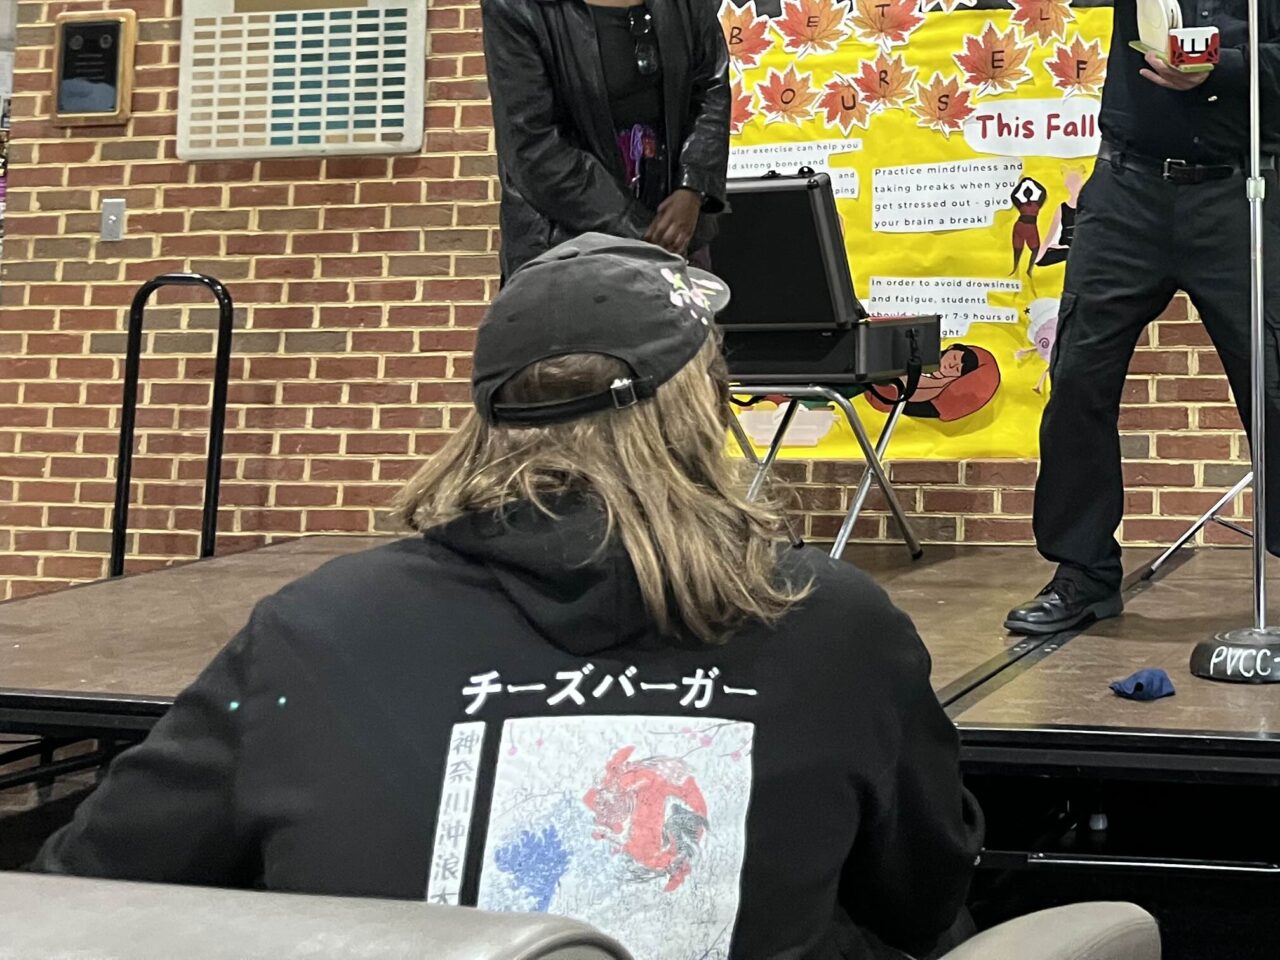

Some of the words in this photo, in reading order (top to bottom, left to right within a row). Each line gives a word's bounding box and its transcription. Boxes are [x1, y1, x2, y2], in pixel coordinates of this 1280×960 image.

[976, 114, 1034, 139] This
[1046, 113, 1094, 139] Fall
[754, 146, 792, 154] exercise
[817, 143, 837, 151] help
[776, 160, 803, 168] bones
[875, 168, 922, 176] Practice
[928, 164, 998, 174] mindfulness
[1003, 162, 1023, 170] and
[875, 185, 910, 193] taking
[917, 183, 955, 191] breaks
[961, 182, 990, 190] when
[996, 182, 1015, 190] you
[875, 203, 893, 211] get
[898, 201, 946, 209] stressed
[985, 198, 1008, 207] give
[875, 220, 899, 228] your
[905, 217, 934, 226] brain
[950, 216, 987, 224] break!
[966, 280, 1020, 289] drowsiness
[895, 296, 937, 304] fatigue,
[941, 296, 986, 304] students
[462, 663, 758, 715] チーズバーガー
